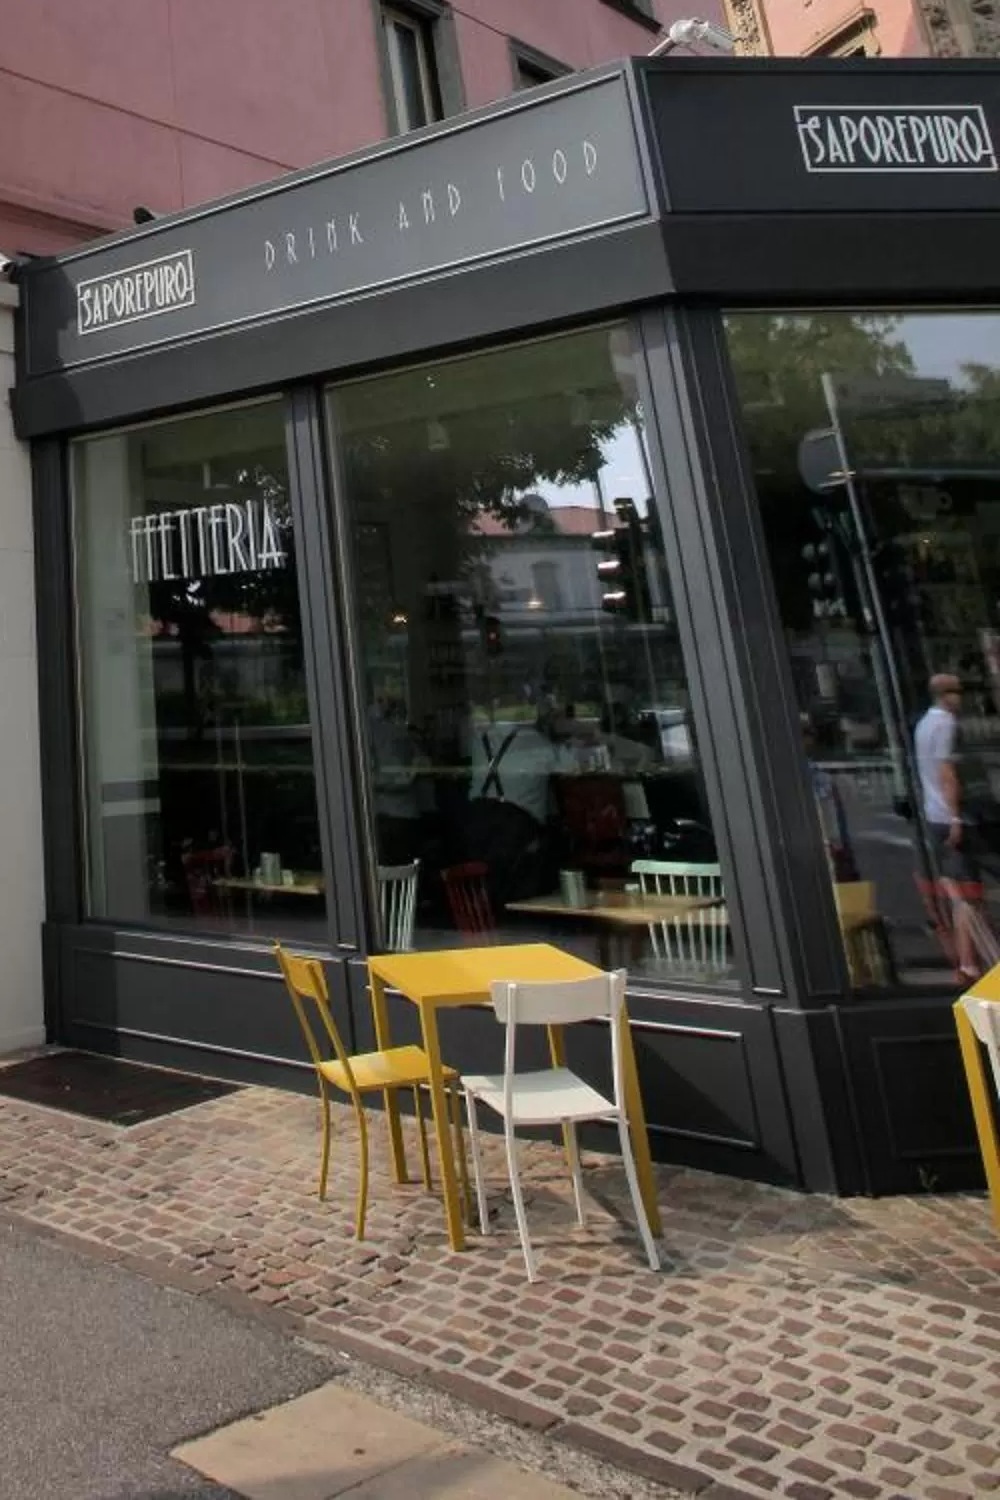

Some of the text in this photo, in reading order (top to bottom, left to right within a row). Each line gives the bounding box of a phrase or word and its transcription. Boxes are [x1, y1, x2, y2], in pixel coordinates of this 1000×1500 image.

[804, 115, 984, 163] SAPOREPURO
[264, 212, 364, 271] DRINK
[400, 183, 462, 231] AND
[80, 260, 190, 328] SAPOREPURO
